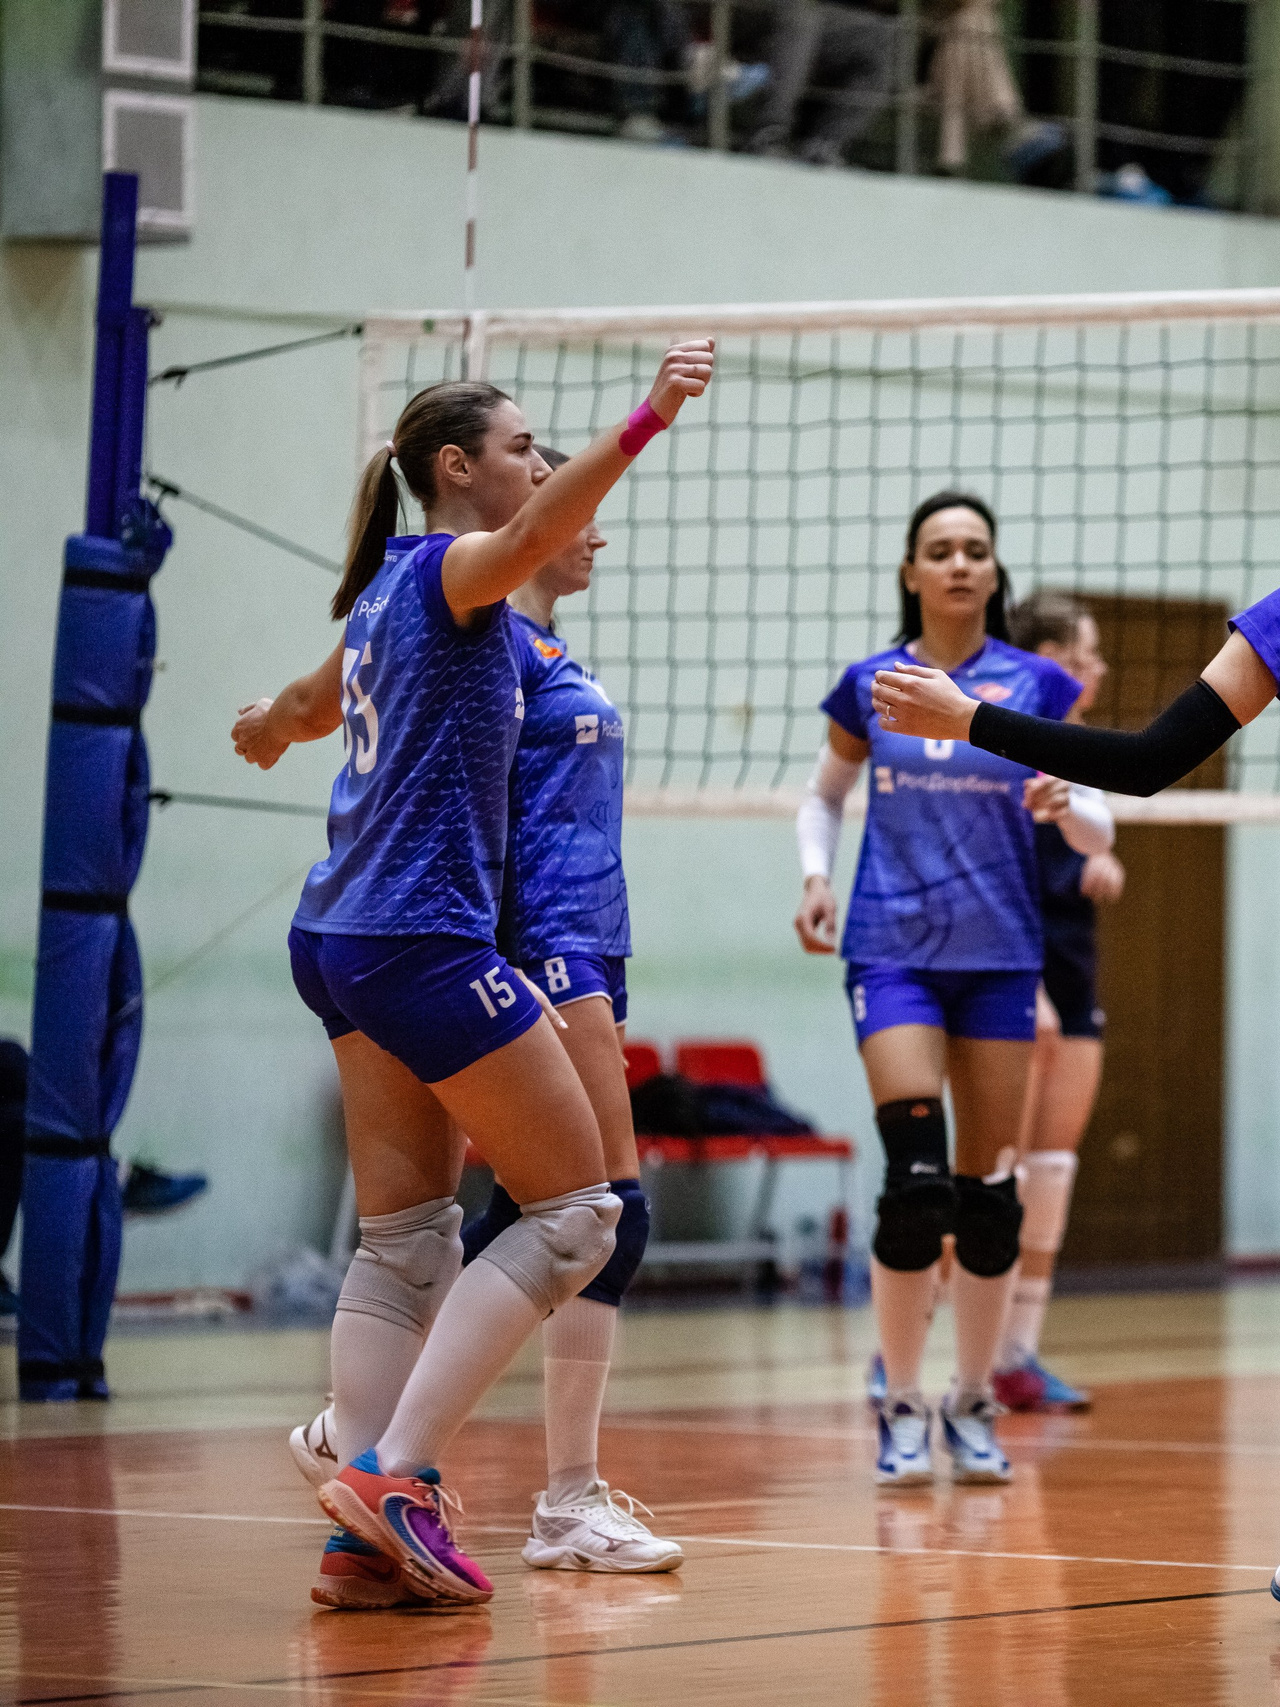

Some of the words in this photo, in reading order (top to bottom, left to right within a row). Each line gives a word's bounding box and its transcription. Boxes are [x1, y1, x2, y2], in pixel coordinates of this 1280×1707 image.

[341, 641, 378, 777] 15
[469, 966, 516, 1019] 15
[544, 957, 571, 995] 8
